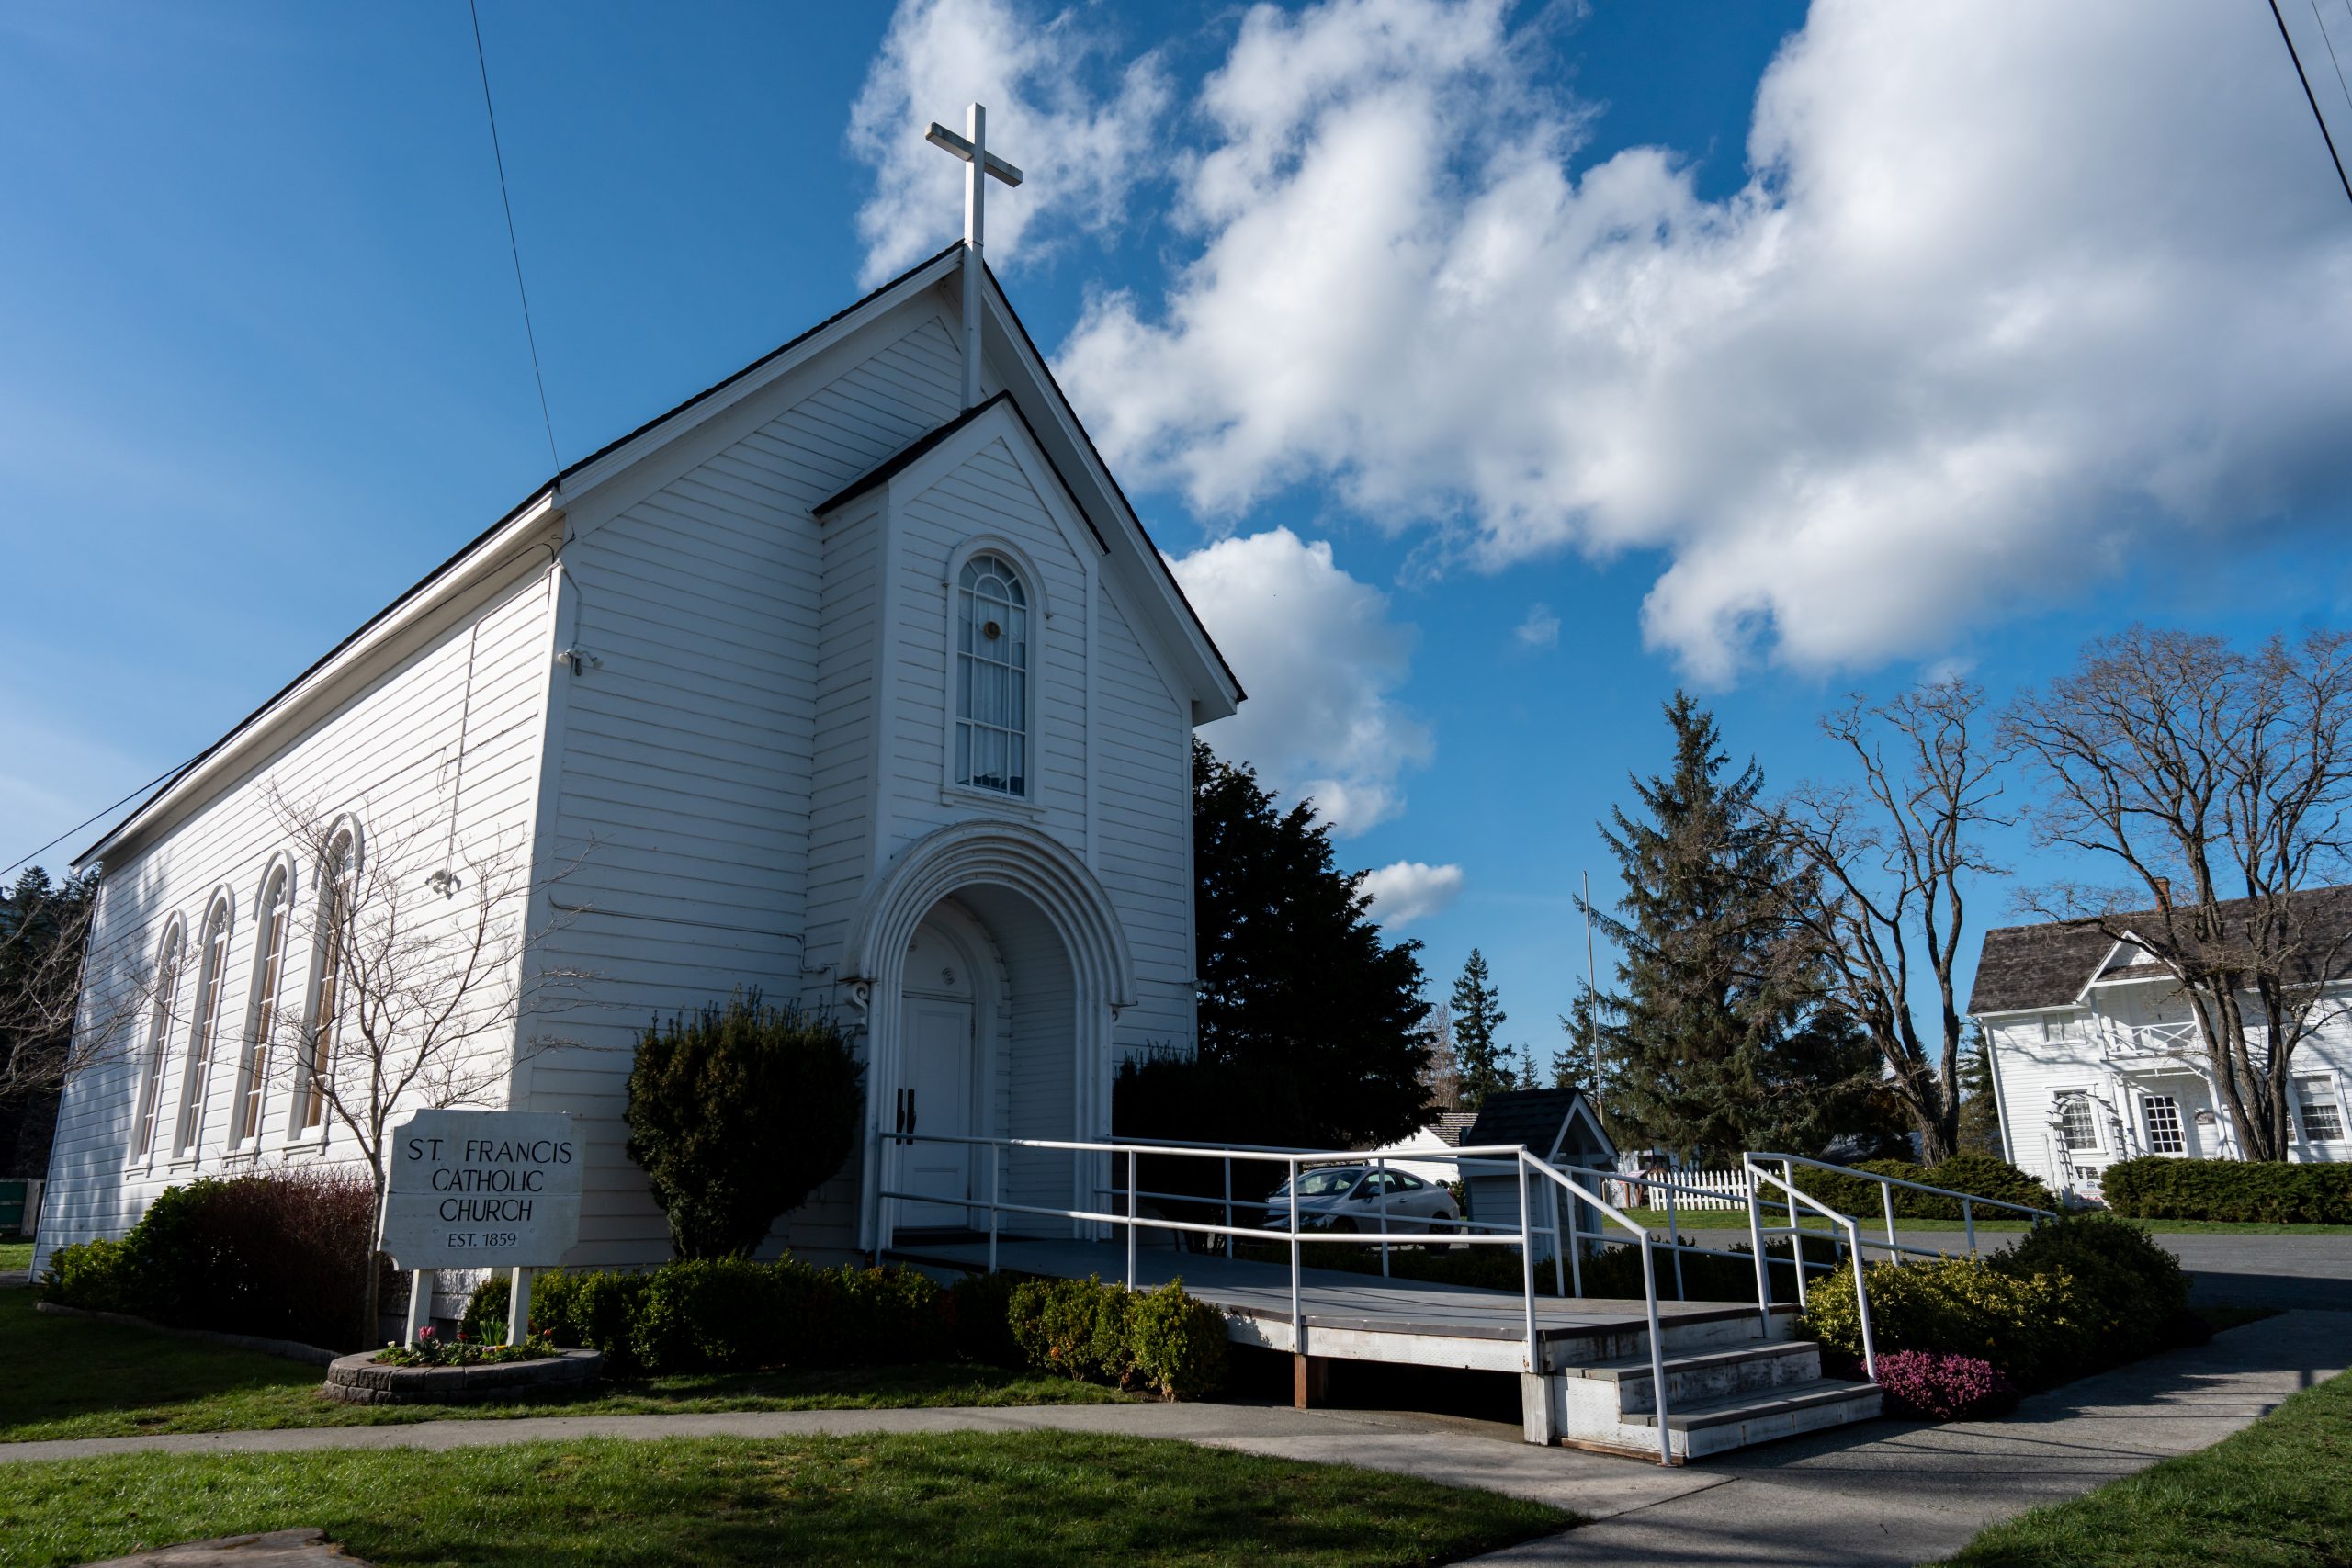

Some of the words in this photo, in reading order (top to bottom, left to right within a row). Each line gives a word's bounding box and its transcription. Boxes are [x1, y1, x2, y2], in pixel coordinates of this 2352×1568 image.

[408, 1138, 443, 1161] ST.
[465, 1140, 572, 1164] FRANCIS
[432, 1168, 544, 1192] CATHOLIC
[439, 1198, 533, 1222] CHURCH
[447, 1233, 477, 1247] EST.
[482, 1232, 516, 1247] 1859
